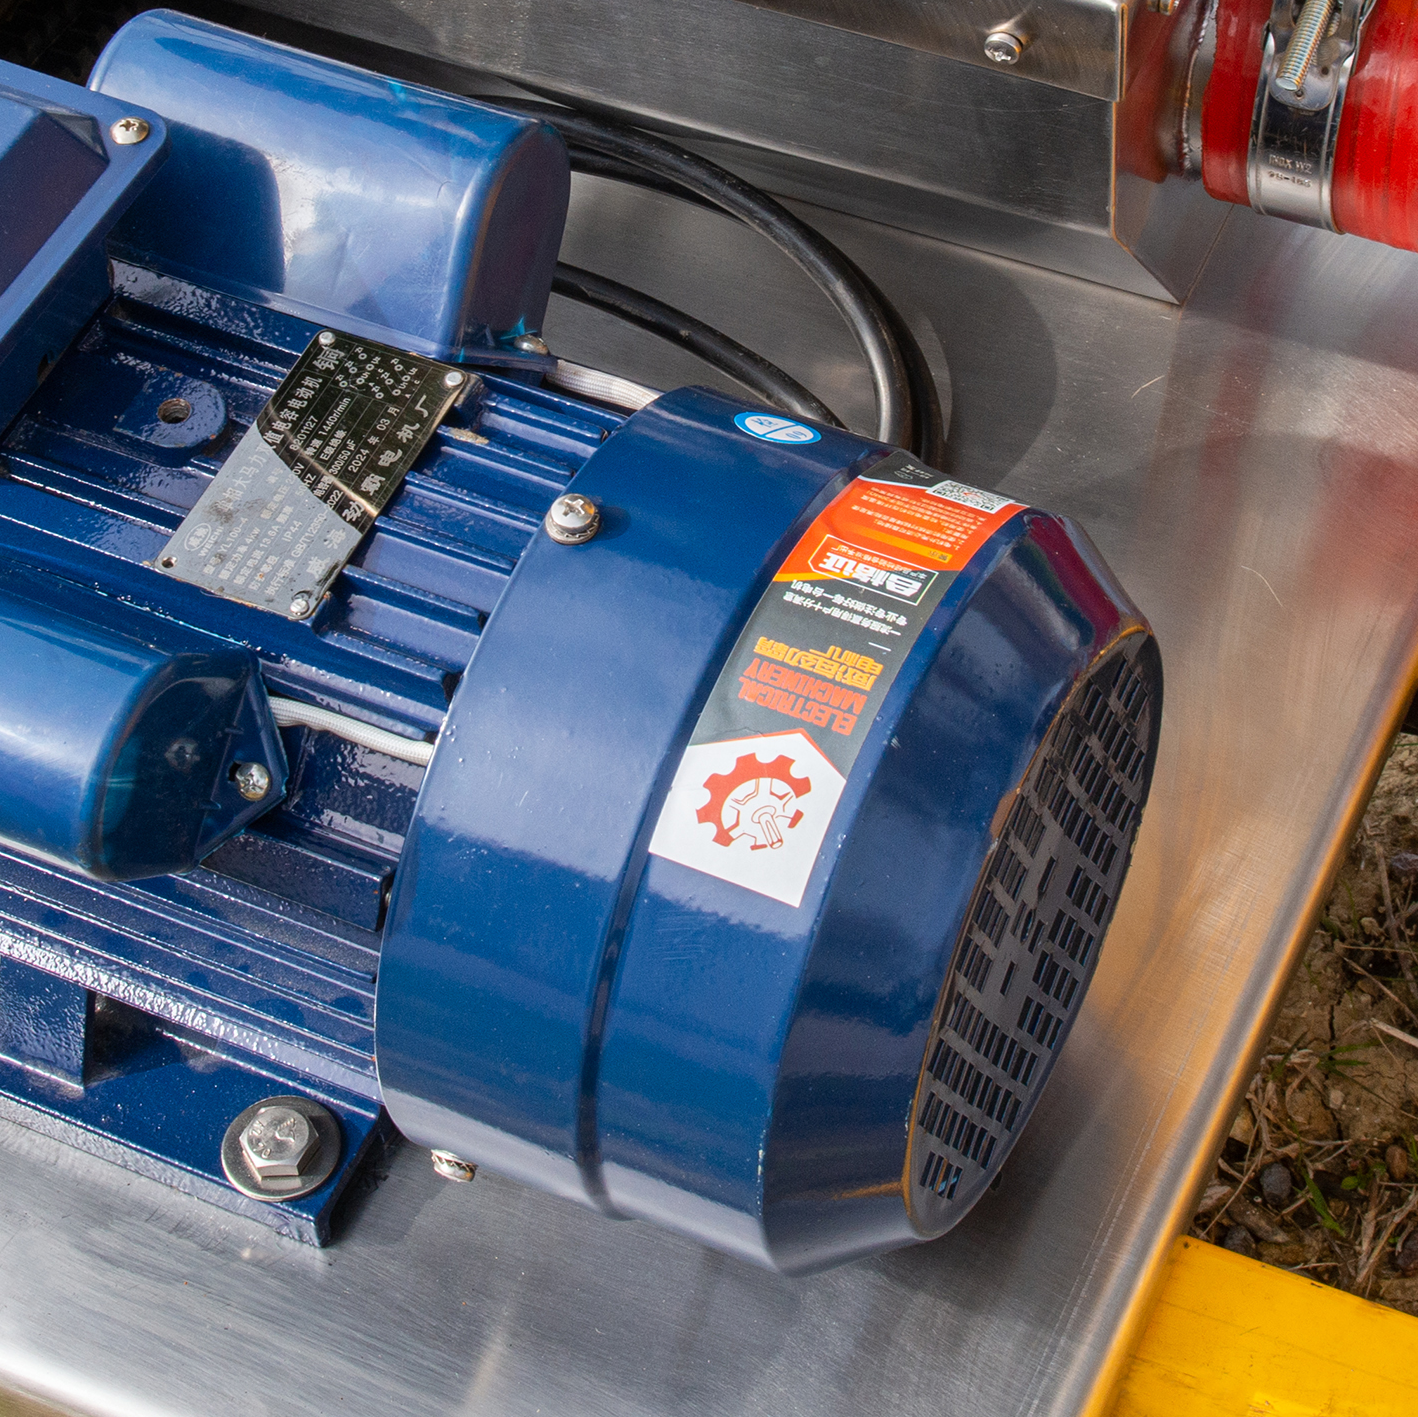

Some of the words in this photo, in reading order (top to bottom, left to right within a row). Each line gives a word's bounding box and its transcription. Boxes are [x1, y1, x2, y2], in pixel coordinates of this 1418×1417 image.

[310, 344, 346, 373] 铜
[288, 414, 320, 451] 8201127
[303, 437, 324, 457] 转速
[317, 395, 352, 436] 1440r/min
[346, 447, 371, 473] 2024
[365, 433, 382, 446] 年
[374, 417, 391, 431] 03
[385, 405, 401, 416] 月
[274, 504, 295, 524] 频率
[294, 472, 316, 496] 50HZ
[284, 461, 306, 484] 220V
[301, 393, 439, 579] 威海劲霸电机厂
[197, 524, 225, 557] WEICHI
[217, 515, 249, 553] YL100-4
[232, 548, 265, 585] 额定电流
[258, 523, 281, 549] 13.6A
[247, 553, 280, 591] 防护等级
[281, 519, 303, 542] IP44
[263, 557, 297, 596] 执行标准
[290, 488, 343, 558] GB/T12350-2022
[217, 542, 249, 580] 额定功率
[819, 552, 922, 597] 合格证
[743, 657, 867, 715] MACHINERY
[753, 636, 877, 691] 威海劲霸
[809, 645, 884, 676] 电机厂
[738, 676, 857, 736] ELECTRICAL
